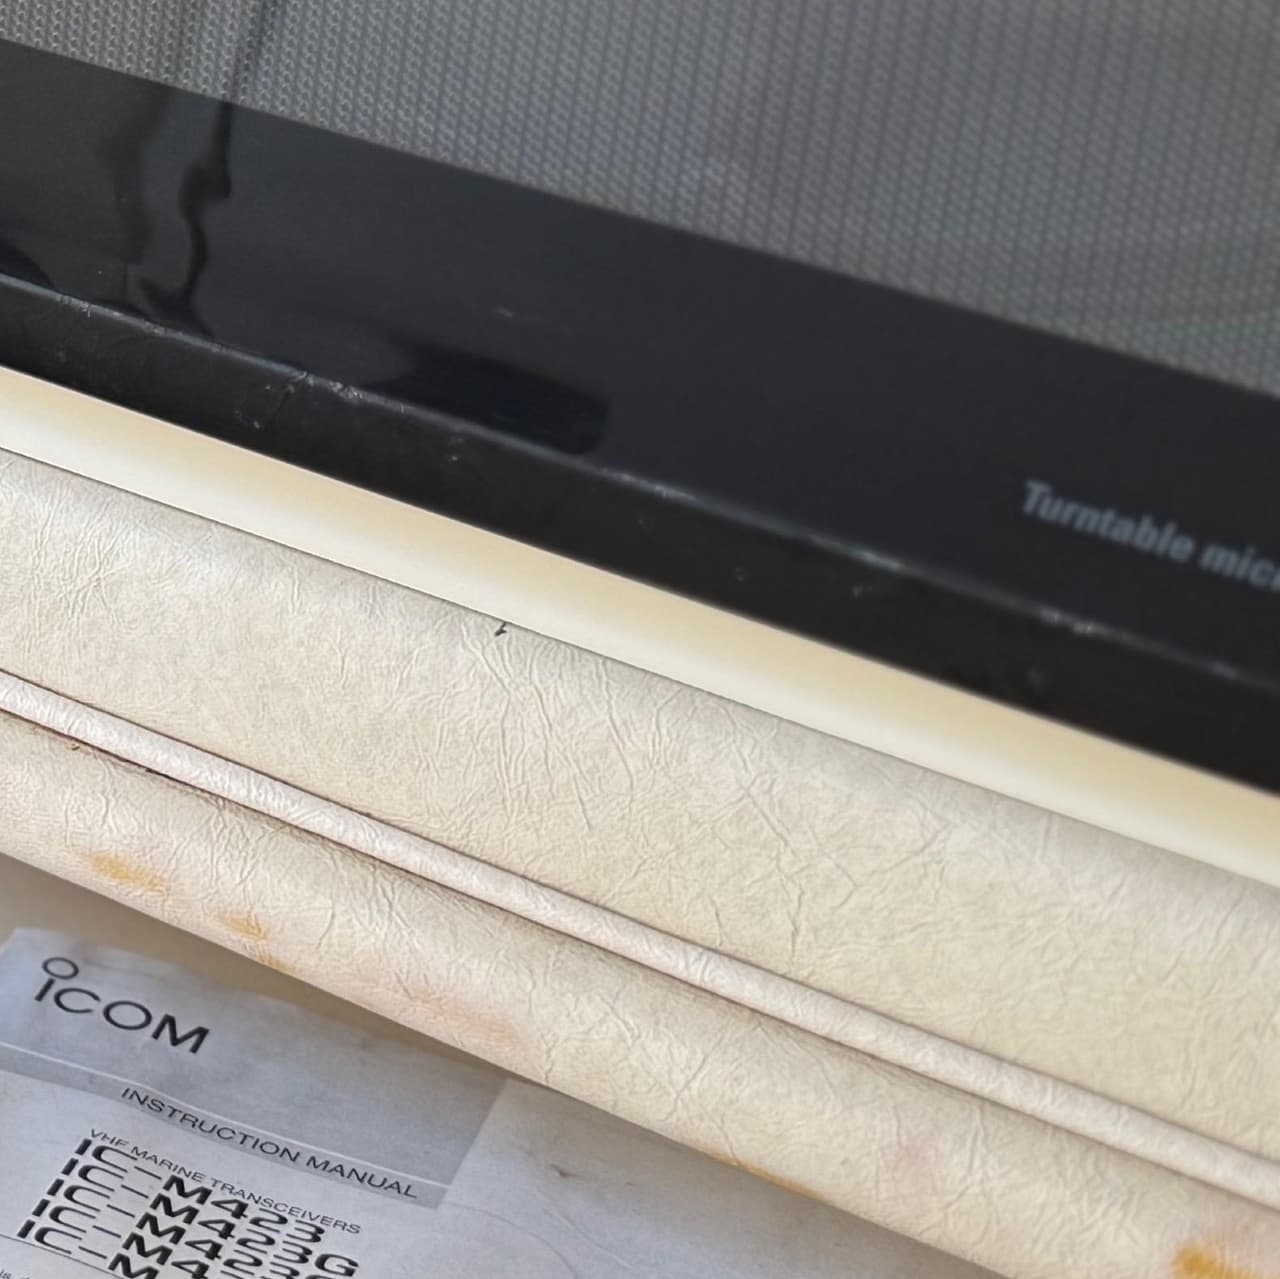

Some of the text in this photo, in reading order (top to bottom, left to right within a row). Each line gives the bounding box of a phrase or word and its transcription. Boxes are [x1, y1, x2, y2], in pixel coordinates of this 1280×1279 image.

[1022, 479, 1196, 564] Turntable
[74, 1138, 326, 1244] IC-M423
[90, 1128, 362, 1235] VHF MARINE TRANSCEIVERS
[121, 1087, 418, 1199] INSTRUCTION MANUAL
[61, 1157, 360, 1278] IC-M423G
